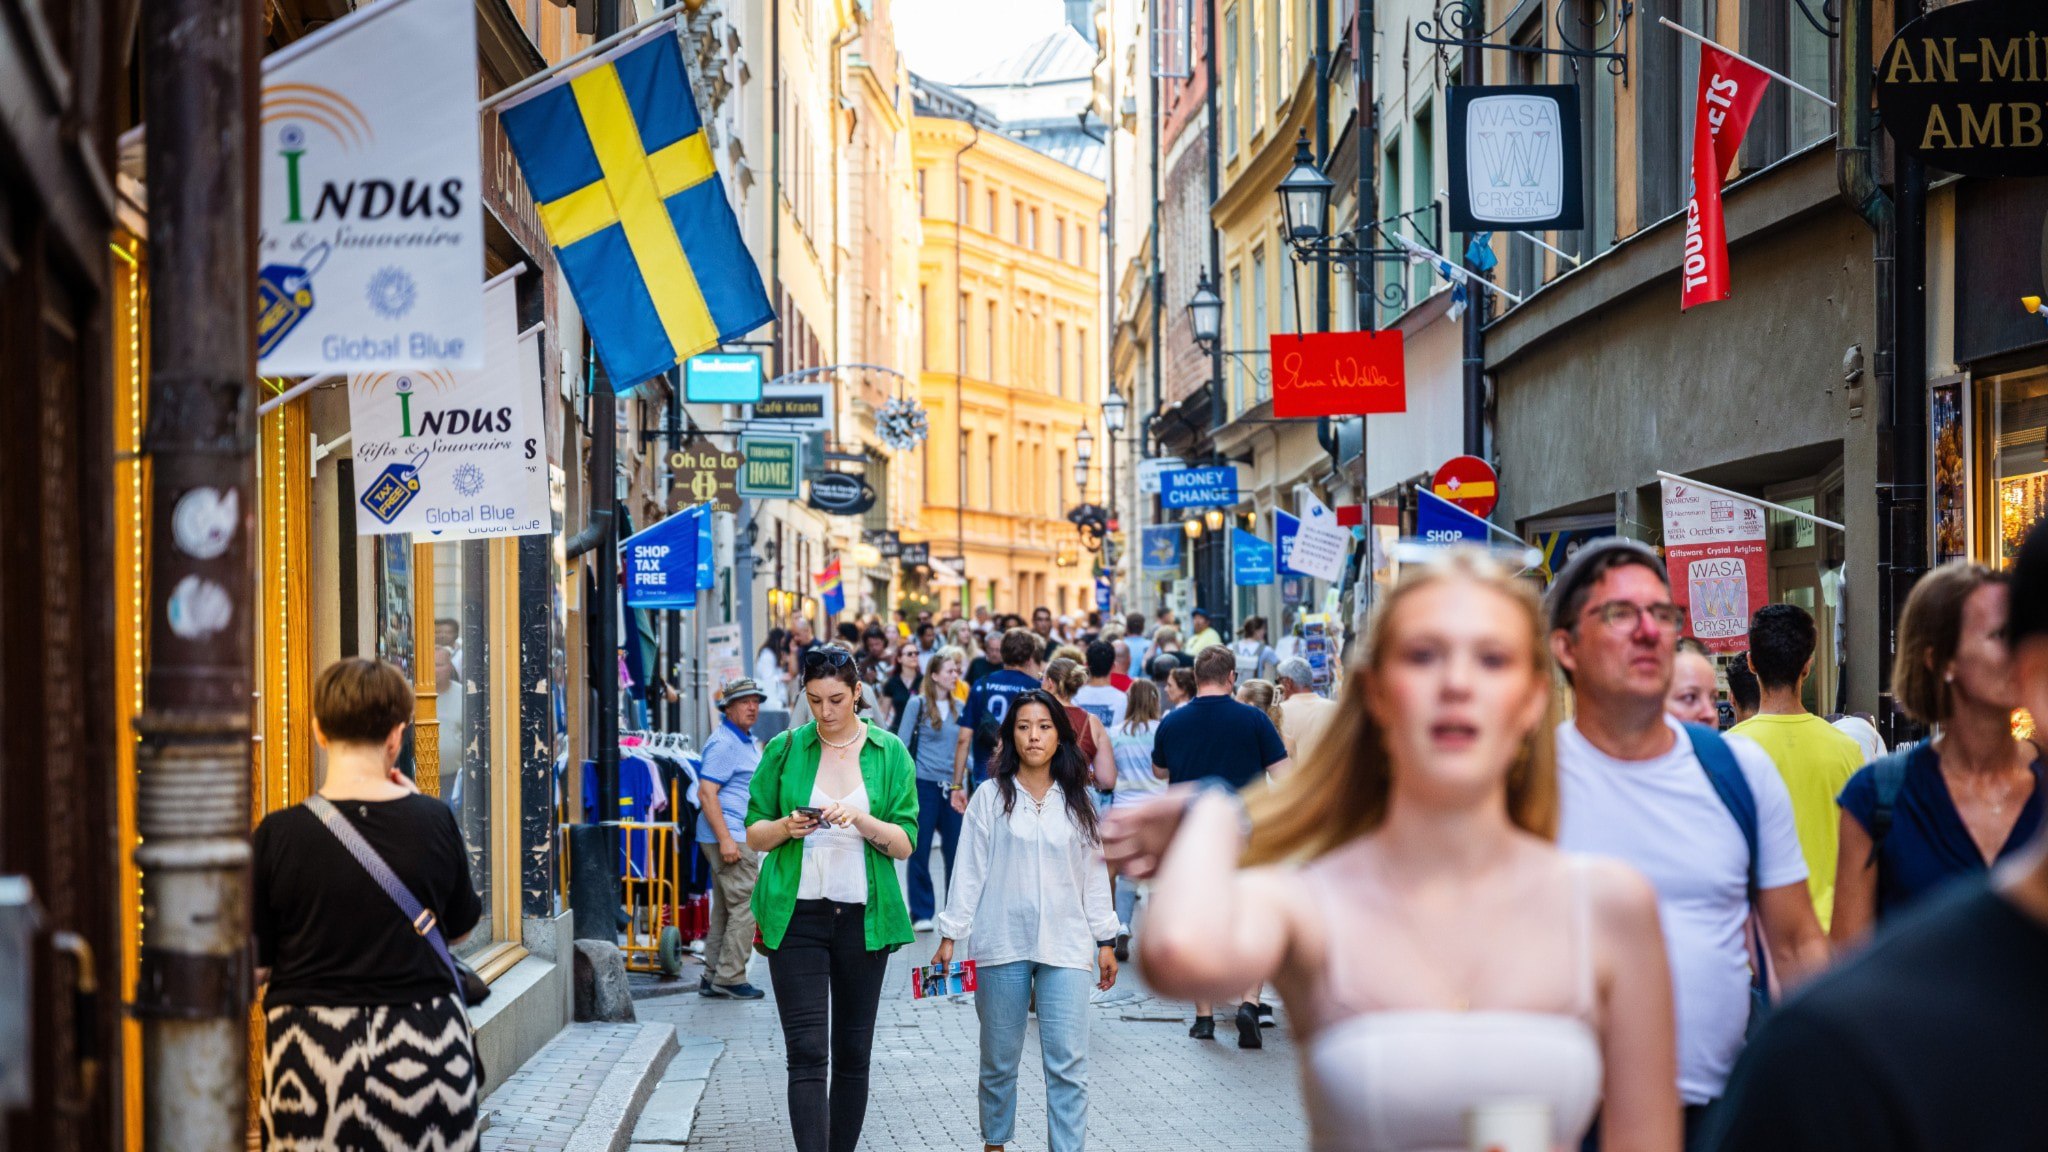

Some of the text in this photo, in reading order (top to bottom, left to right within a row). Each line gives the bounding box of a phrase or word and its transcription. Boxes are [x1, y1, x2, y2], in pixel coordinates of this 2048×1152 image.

[1475, 104, 1552, 126] WASA
[1919, 103, 2048, 149] AMB
[279, 149, 464, 223] INDUS
[1476, 191, 1556, 208] CRYSTAL
[1494, 207, 1539, 216] SWEDEN
[332, 225, 464, 248] Souvenirs
[322, 332, 466, 361] Global Blue
[395, 392, 512, 437] INDUS
[755, 401, 819, 413] Café Krans
[357, 441, 398, 462] Gifts
[405, 443, 419, 455] &
[424, 438, 512, 455] Souvenirs
[671, 452, 738, 468] Oh la la
[749, 460, 790, 485] HOME
[1173, 471, 1225, 487] MONEY
[374, 483, 393, 501] TAX
[379, 486, 405, 515] FREE
[1169, 487, 1230, 504] CHANGE
[1665, 497, 1700, 506] SWAROVSKI
[426, 505, 515, 524] Global Blue
[1426, 530, 1462, 542] SHOP
[634, 545, 670, 558] SHOP
[1670, 545, 1763, 558] Giftsware Crystal Artglass
[634, 559, 660, 571] TAX
[1692, 561, 1743, 578] WASA
[635, 572, 667, 585] FREE
[1694, 618, 1747, 632] CRYSTAL
[1706, 629, 1736, 637] SWEDEN
